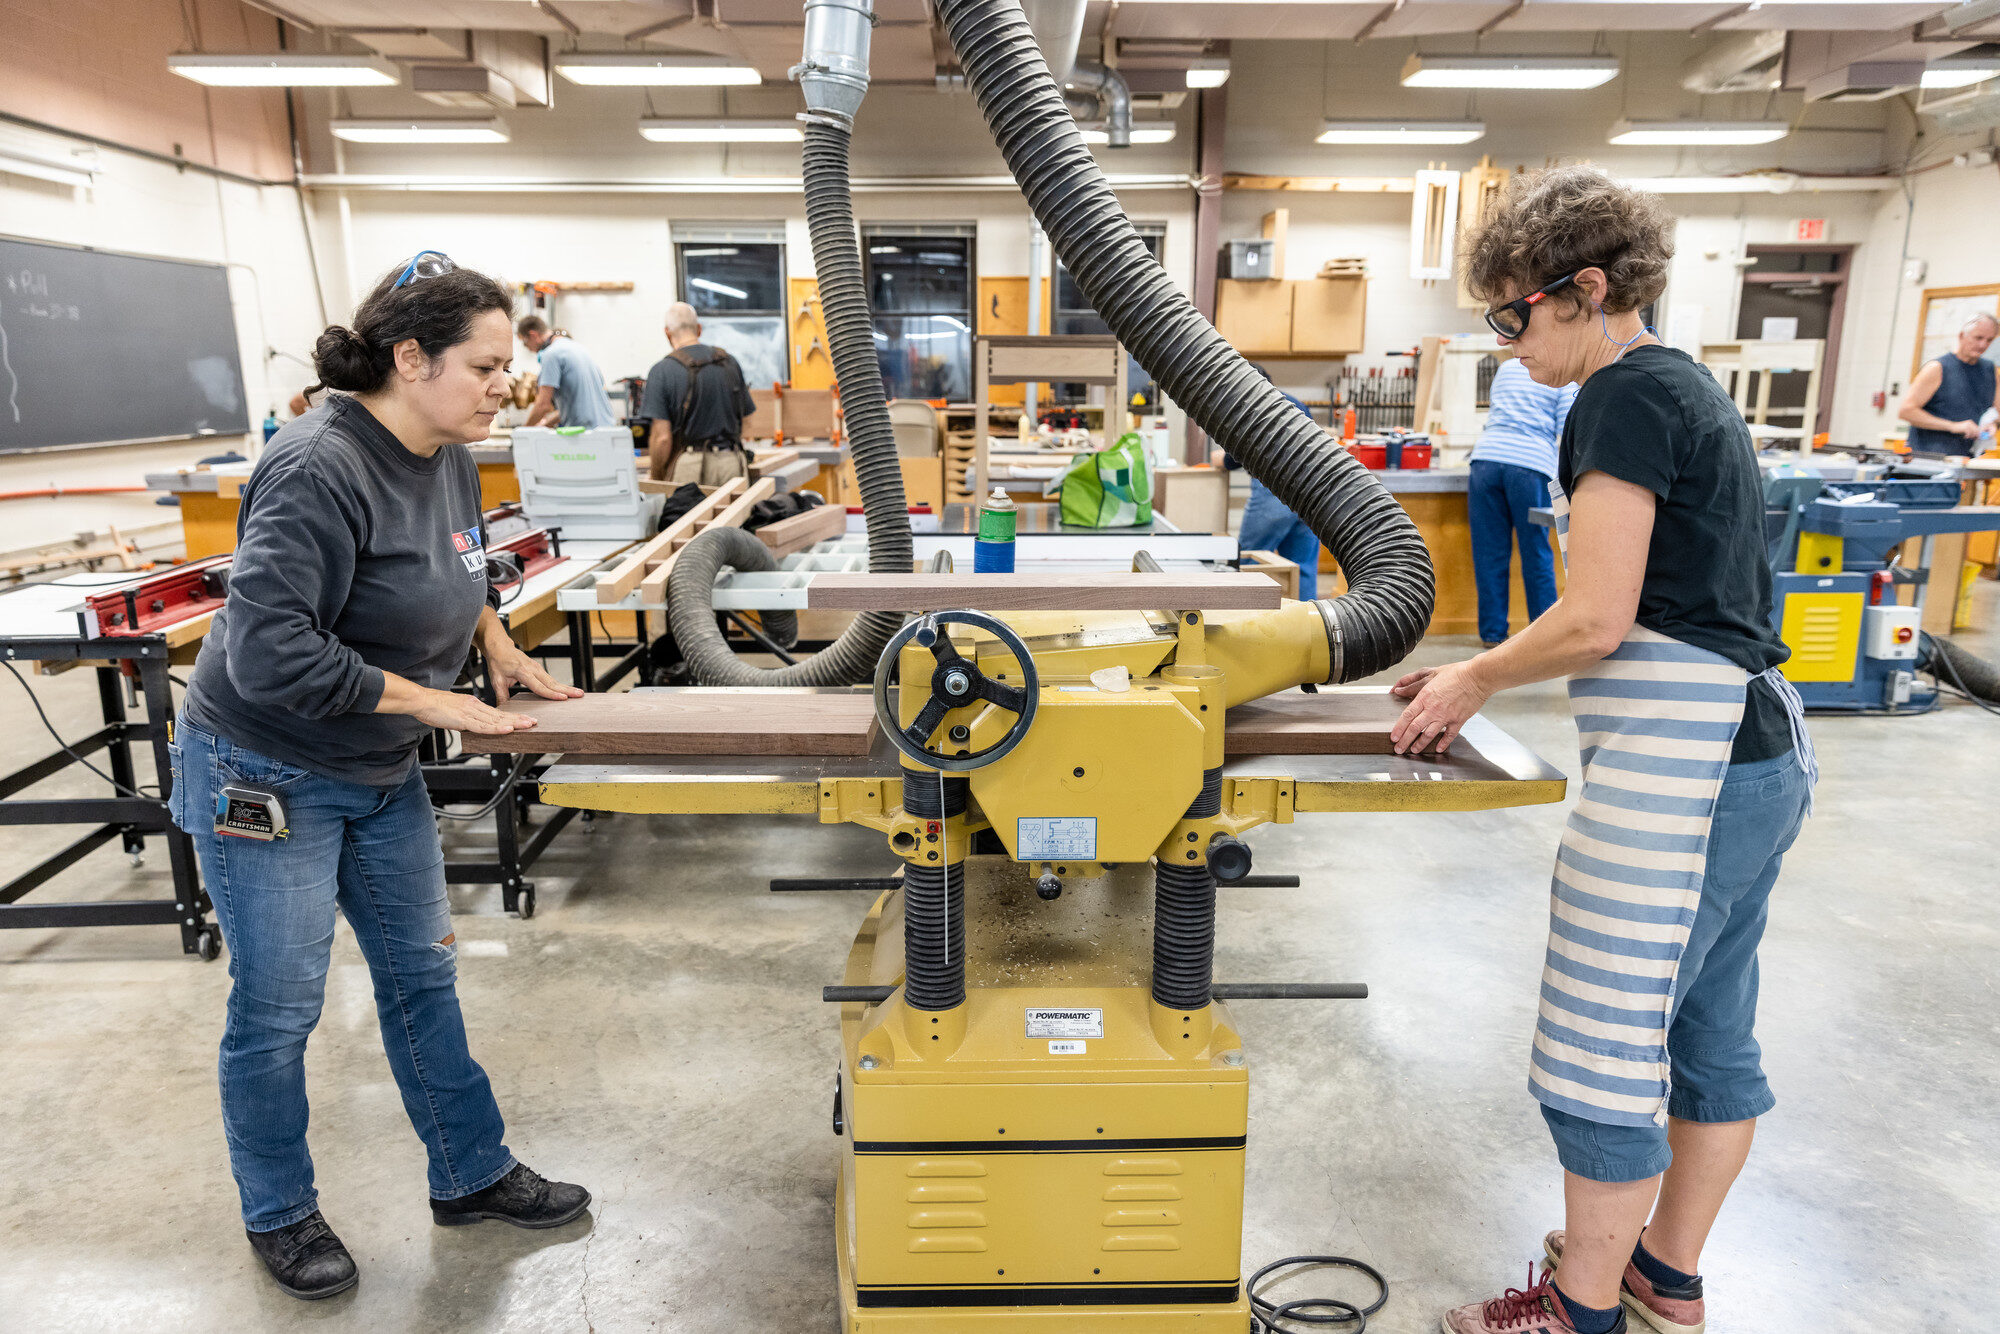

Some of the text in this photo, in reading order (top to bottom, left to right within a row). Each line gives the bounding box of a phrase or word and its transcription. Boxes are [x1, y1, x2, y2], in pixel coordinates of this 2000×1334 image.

[1798, 218, 1825, 240] EXIT
[227, 820, 271, 833] CRAFTSMAN
[1035, 1012, 1091, 1020] POWERMATIC
